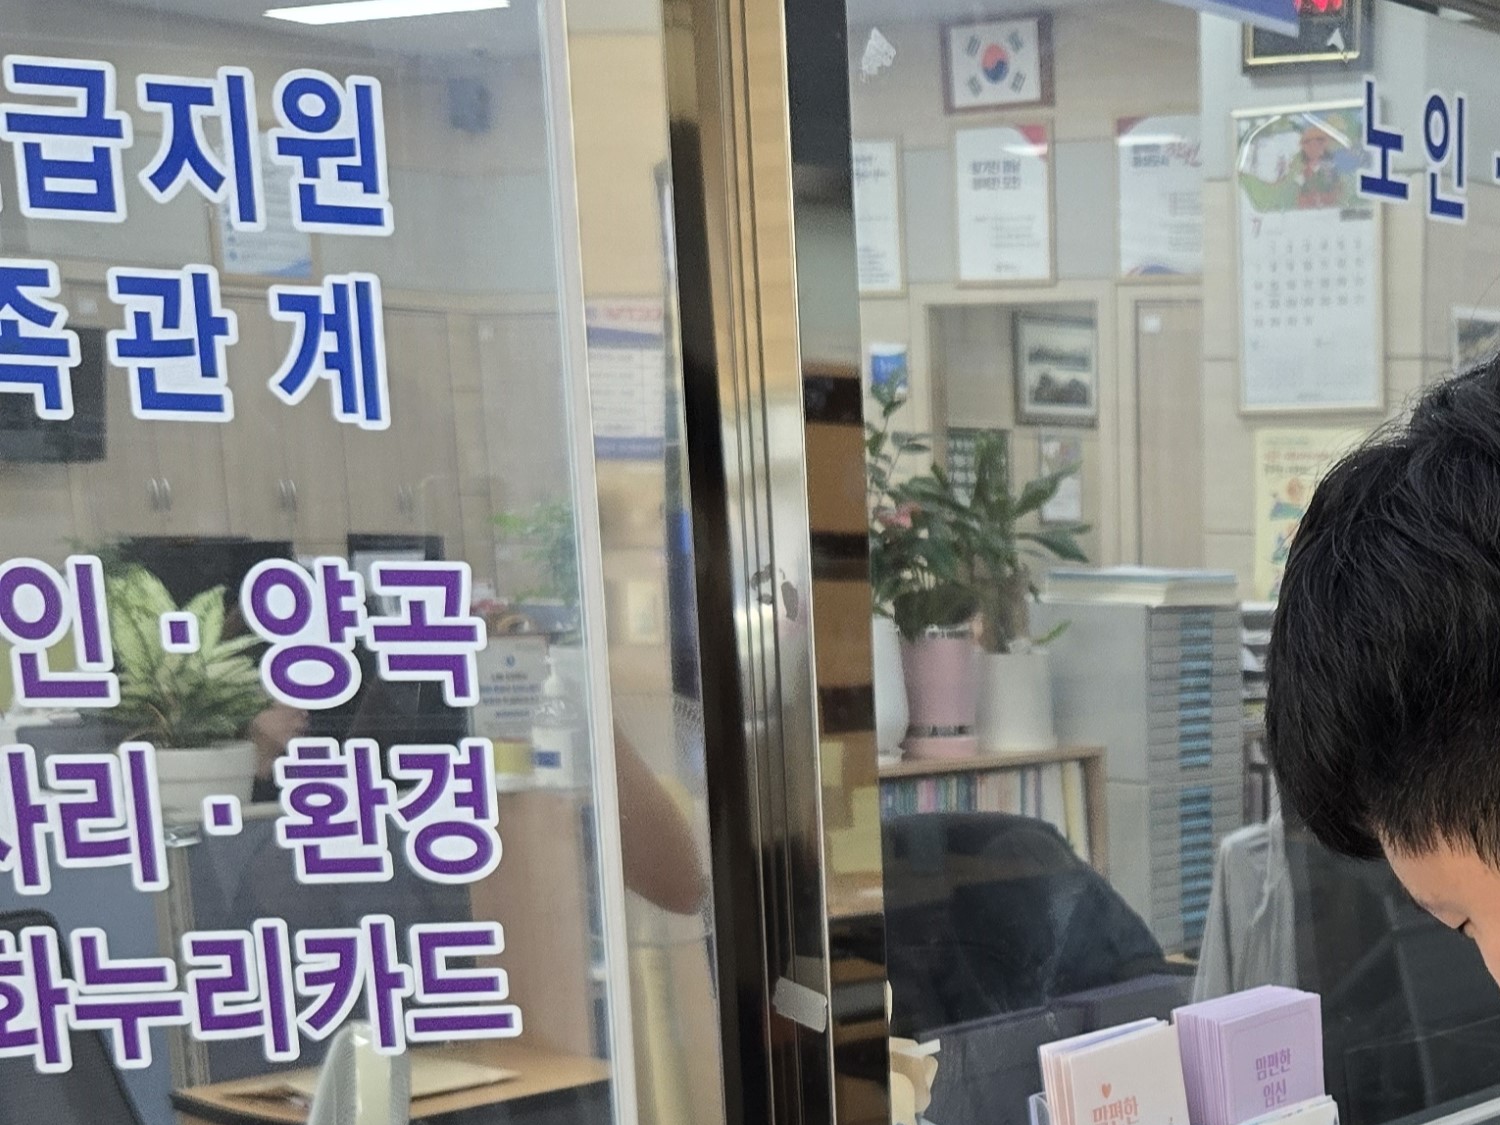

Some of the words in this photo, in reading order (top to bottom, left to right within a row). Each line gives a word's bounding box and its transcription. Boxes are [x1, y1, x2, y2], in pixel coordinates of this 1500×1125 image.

[4, 58, 390, 232] 급지원
[1358, 78, 1467, 222] 노인
[0, 558, 116, 704] 인
[246, 560, 484, 705] 양곡
[280, 740, 497, 880] 환경
[1255, 1047, 1291, 1081] 맘편한
[1263, 1078, 1287, 1109] 임신
